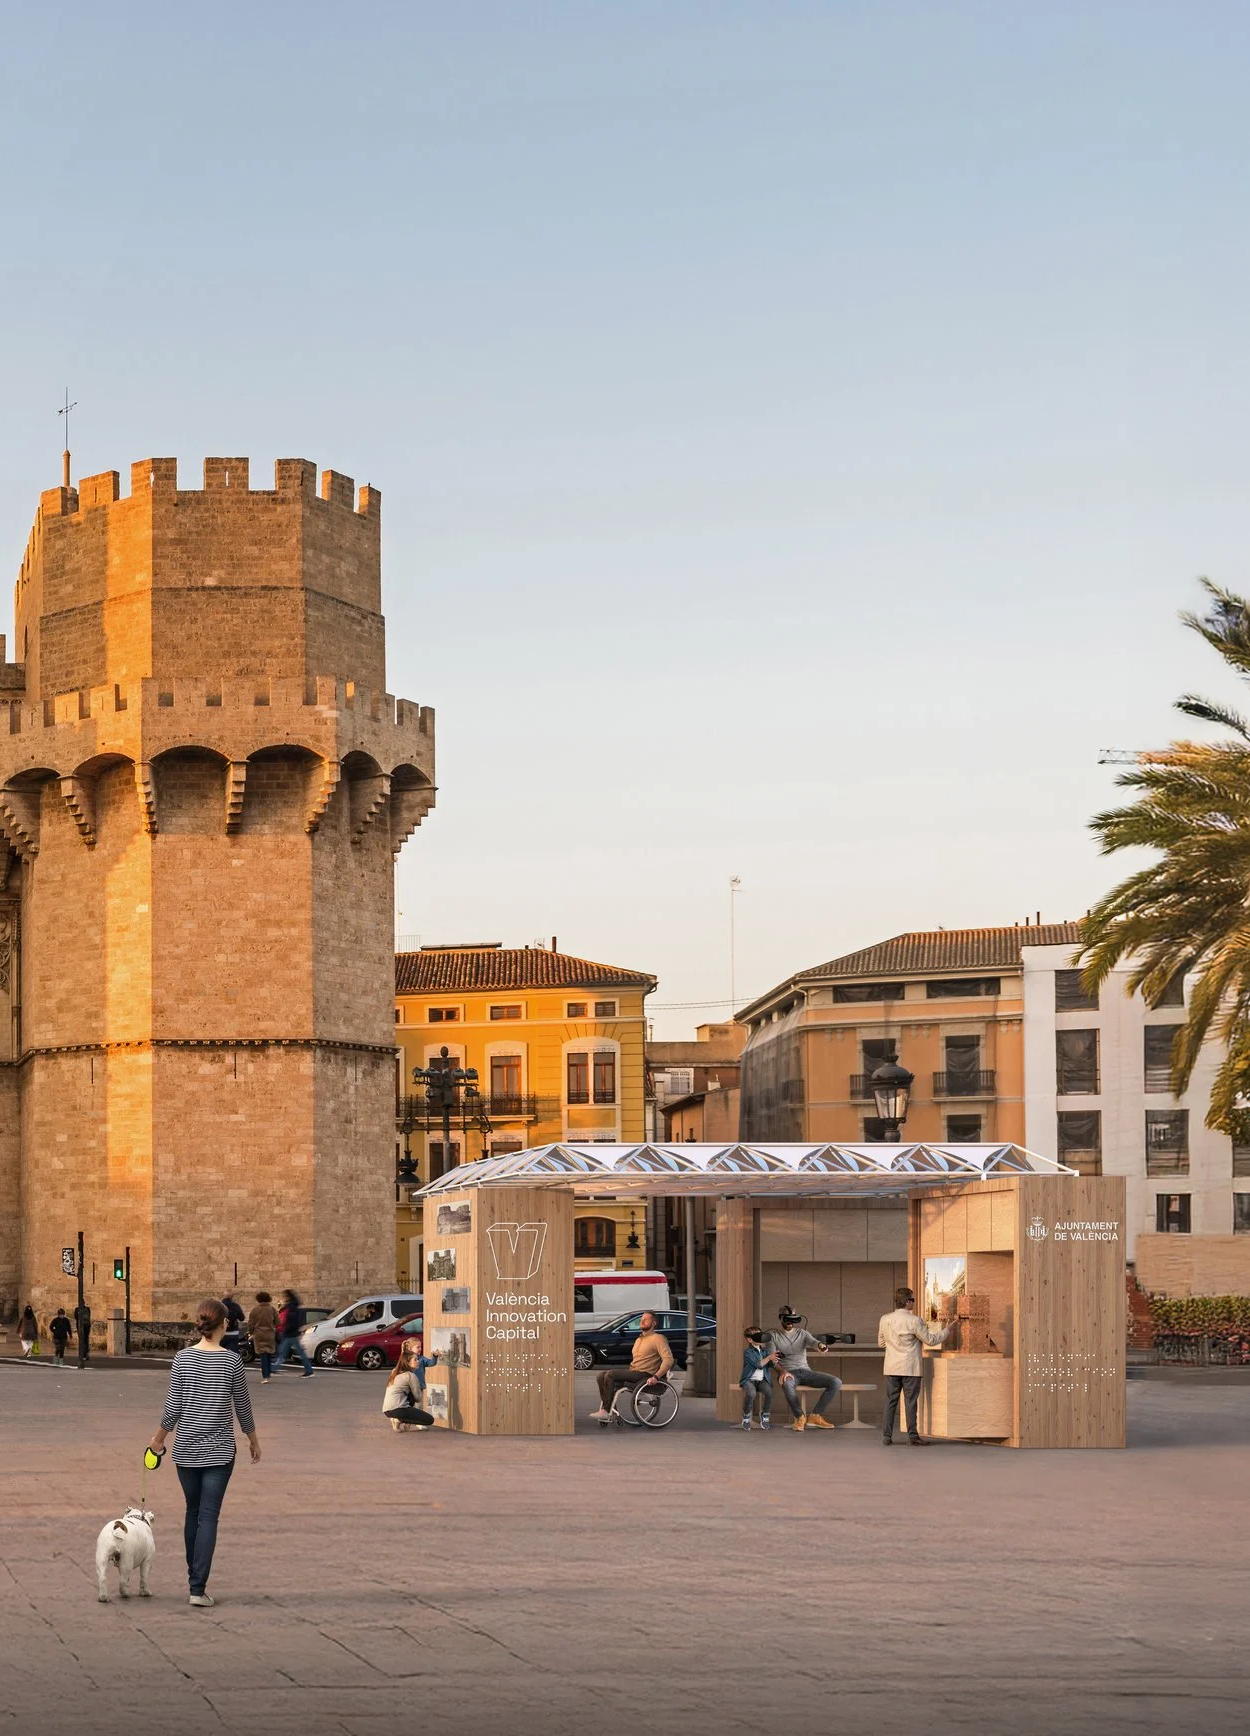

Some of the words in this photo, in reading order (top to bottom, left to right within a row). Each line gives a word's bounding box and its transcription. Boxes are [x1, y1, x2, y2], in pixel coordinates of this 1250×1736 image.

[1054, 1221, 1119, 1230] AJUNTAMENT
[1054, 1232, 1068, 1241] DE
[1070, 1230, 1119, 1241] VALÈNCIA
[485, 1292, 551, 1306] València
[485, 1309, 567, 1323] Innovation
[485, 1325, 540, 1342] Capital
